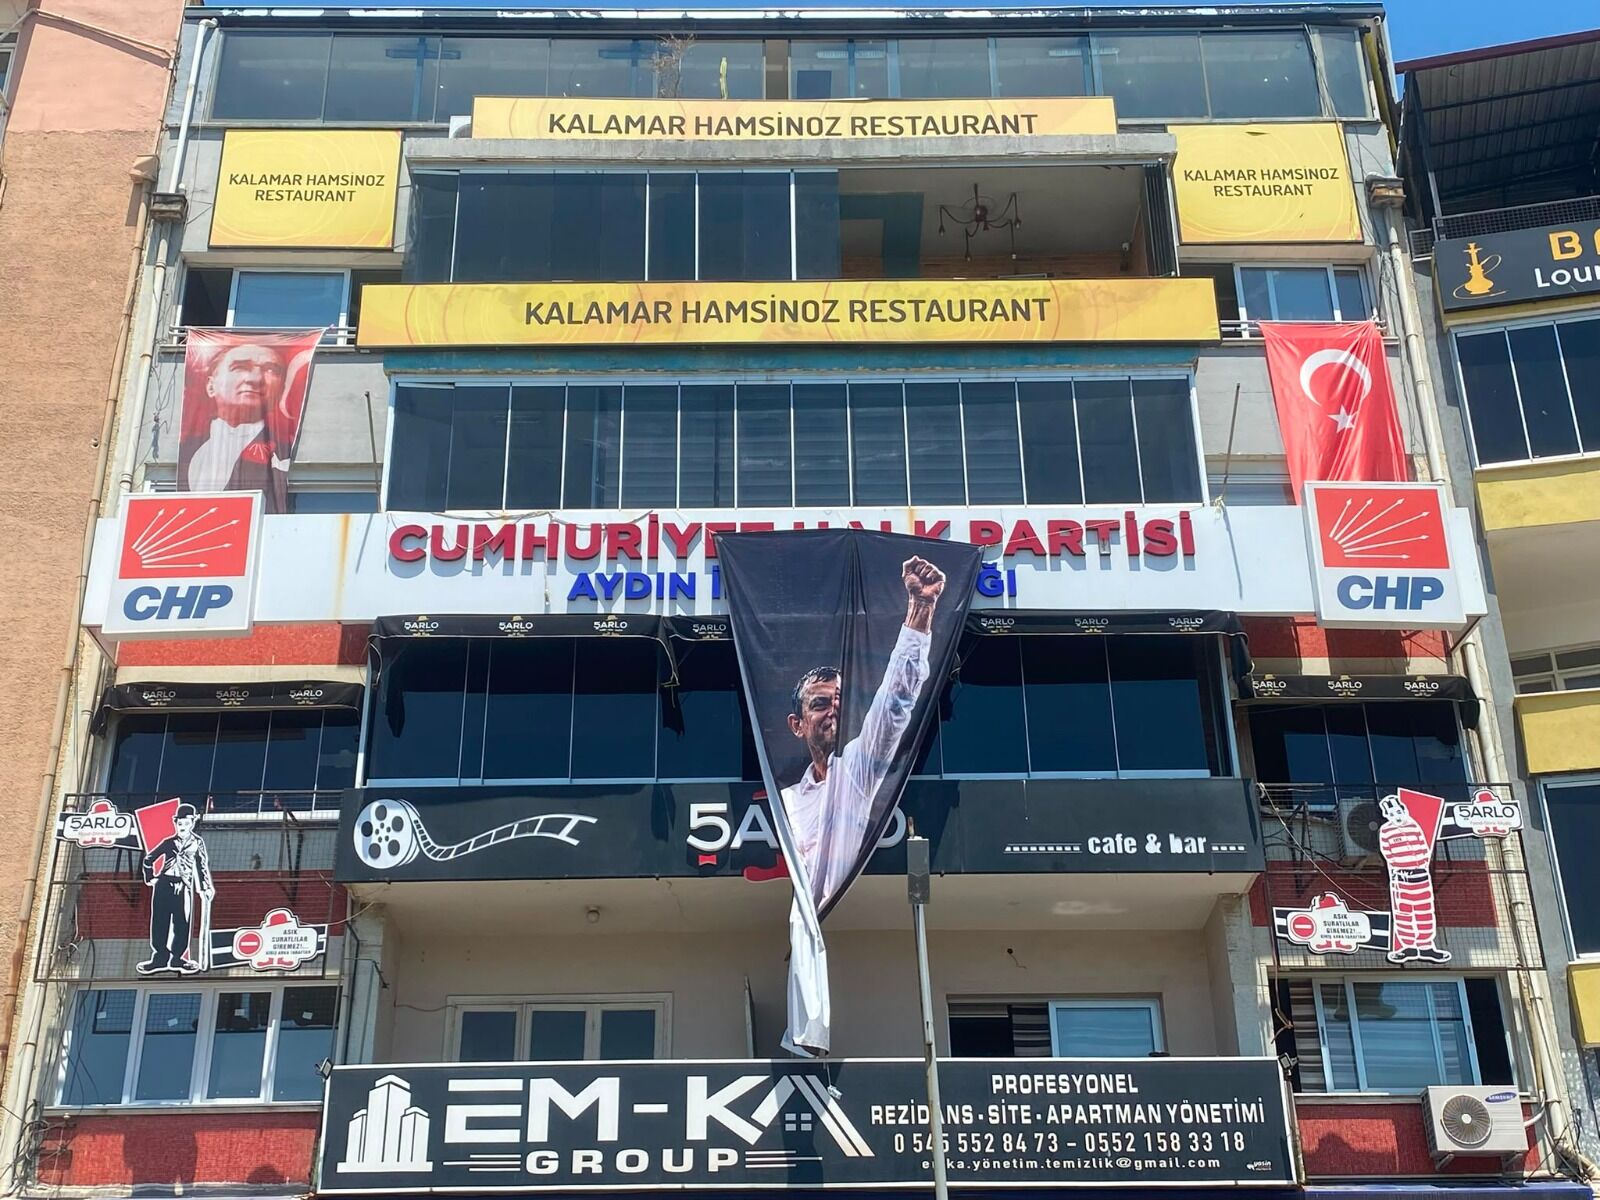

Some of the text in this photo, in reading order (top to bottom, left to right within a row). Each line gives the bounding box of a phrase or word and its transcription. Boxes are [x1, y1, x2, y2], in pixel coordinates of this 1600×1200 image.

[549, 111, 1039, 137] KALAMAR HAMSİNOZ RESTAURANT
[228, 171, 386, 187] KALAMAR HAMSİNOZ
[1184, 166, 1340, 182] KALAMAR HAMSİNOZ
[254, 189, 357, 202] RESTAURANT
[1213, 184, 1314, 197] RESTAURANT
[525, 294, 1051, 325] KALAMAR HAMSİNOZ RESTAURANT
[566, 571, 697, 601] AYDIN
[1336, 575, 1445, 610] CHP
[123, 584, 234, 621] CHP
[1087, 833, 1207, 854] cafe & bar
[991, 1074, 1139, 1094] PROFESYONEL
[870, 1097, 1265, 1125] REZİDNS SİTE APARTMAN YÖNETİMİ
[957, 1133, 995, 1153] 552
[1002, 1133, 1028, 1153] 84
[1033, 1132, 1058, 1153] 73
[1084, 1132, 1136, 1152] 0552
[1143, 1132, 1181, 1152] 158
[1189, 1132, 1214, 1151] 33
[1220, 1131, 1245, 1151] 18
[525, 1148, 739, 1175] GROUP
[921, 1157, 1221, 1172] eka.yönetim.temizlik@gmail.com
